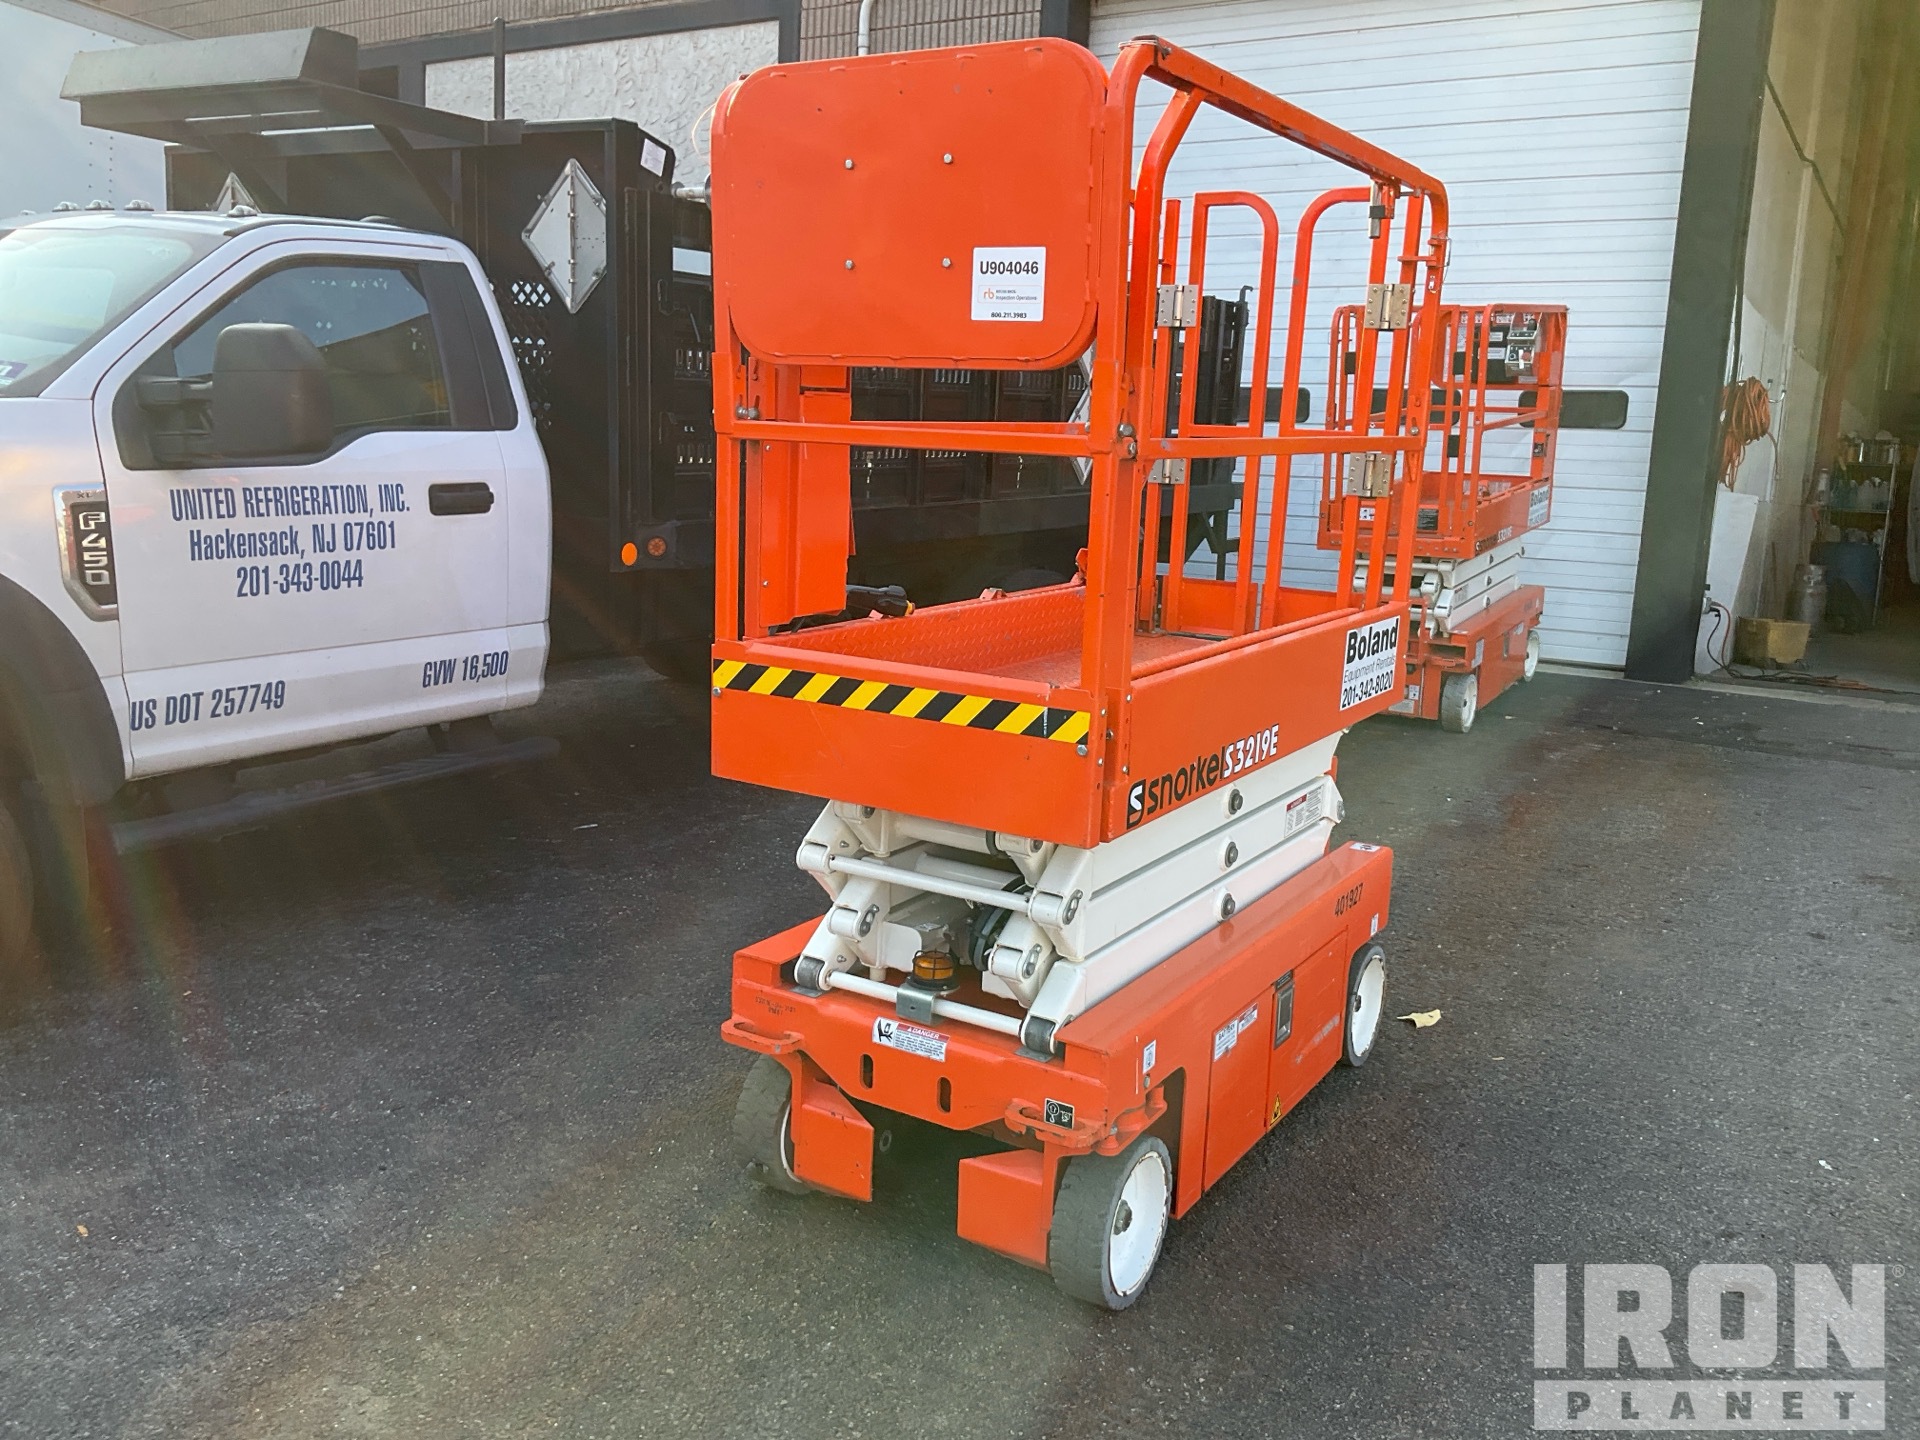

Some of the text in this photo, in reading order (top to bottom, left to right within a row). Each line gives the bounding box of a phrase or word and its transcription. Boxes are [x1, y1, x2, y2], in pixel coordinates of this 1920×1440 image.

[980, 261, 1038, 275] U904046
[170, 483, 410, 521] UNITED REFRIGERATION, INC.
[189, 520, 396, 561] Hackensack, NJ 07601
[236, 559, 364, 597] 201-343-0044
[1346, 618, 1399, 665] Boland
[422, 650, 509, 688] GVW 16,500
[1343, 662, 1376, 684] Equipment
[130, 680, 286, 731] US DOT 257749
[1341, 669, 1394, 708] 201-342-8020
[1147, 746, 1226, 815] snorkel
[1223, 723, 1280, 778] S3219E
[1334, 882, 1364, 917] 401927
[912, 1028, 940, 1040] DANGER
